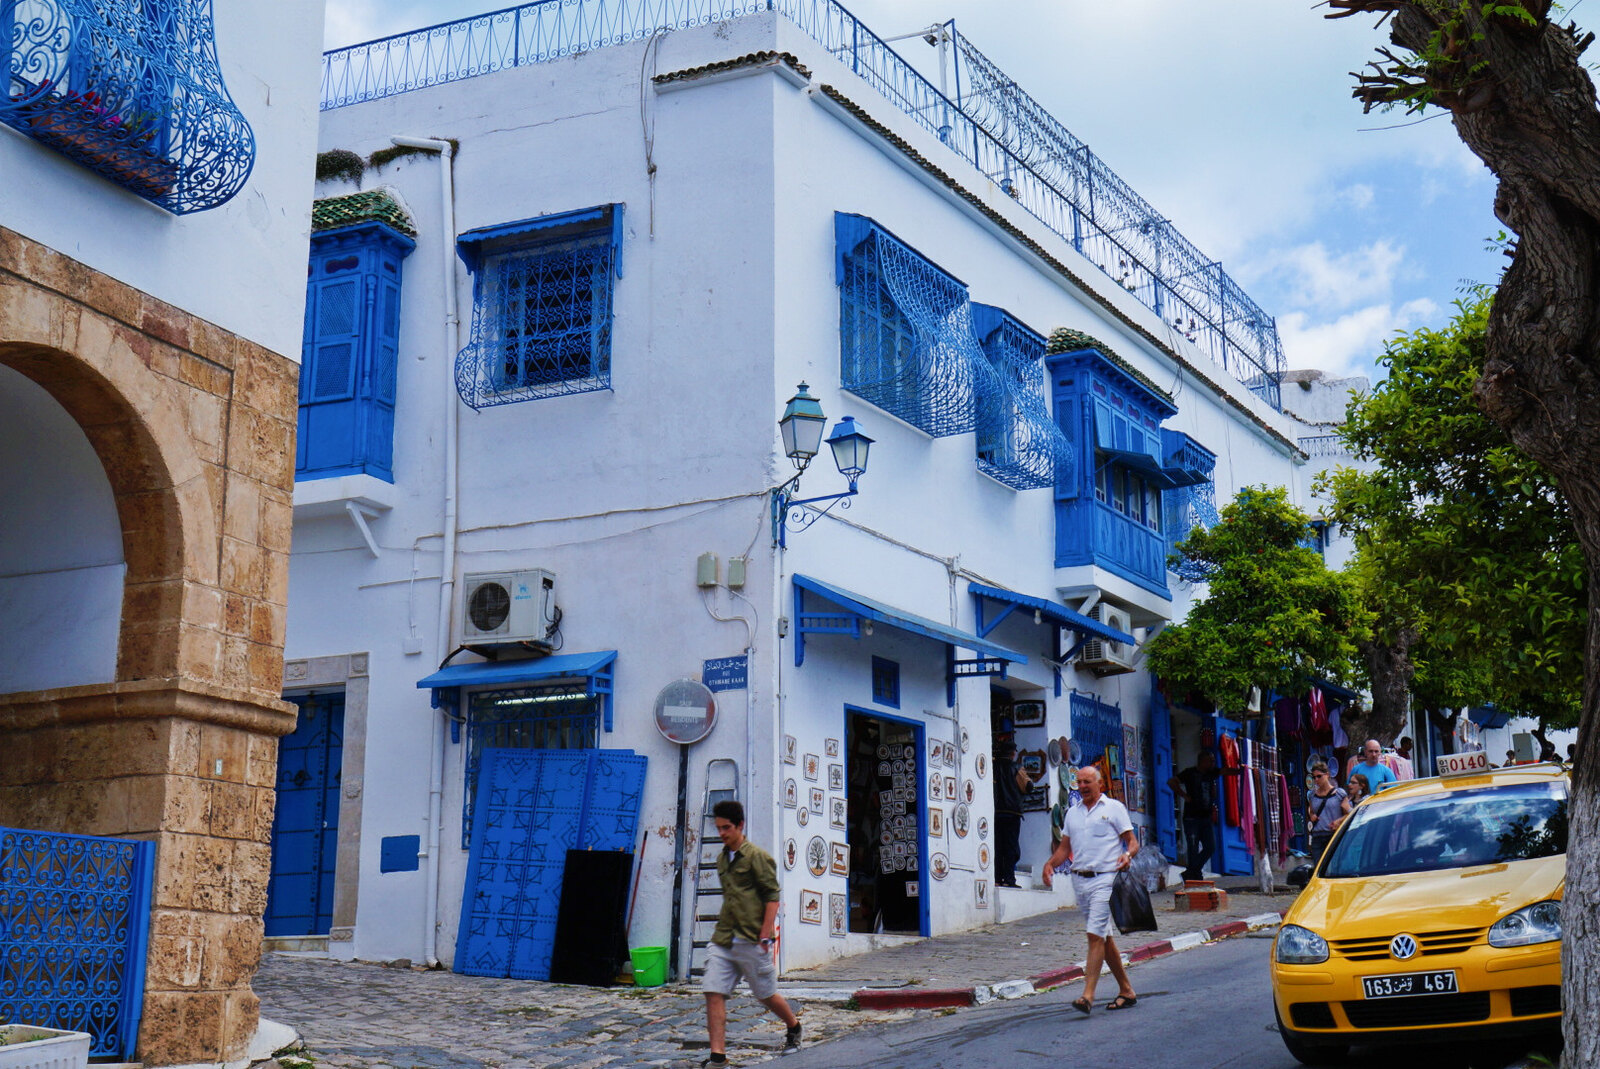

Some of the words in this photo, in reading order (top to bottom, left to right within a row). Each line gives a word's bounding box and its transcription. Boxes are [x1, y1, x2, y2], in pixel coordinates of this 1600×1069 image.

[1449, 754, 1486, 771] 0140
[1366, 978, 1392, 996] 163
[1393, 976, 1413, 993] تونس
[1424, 973, 1454, 991] 467
